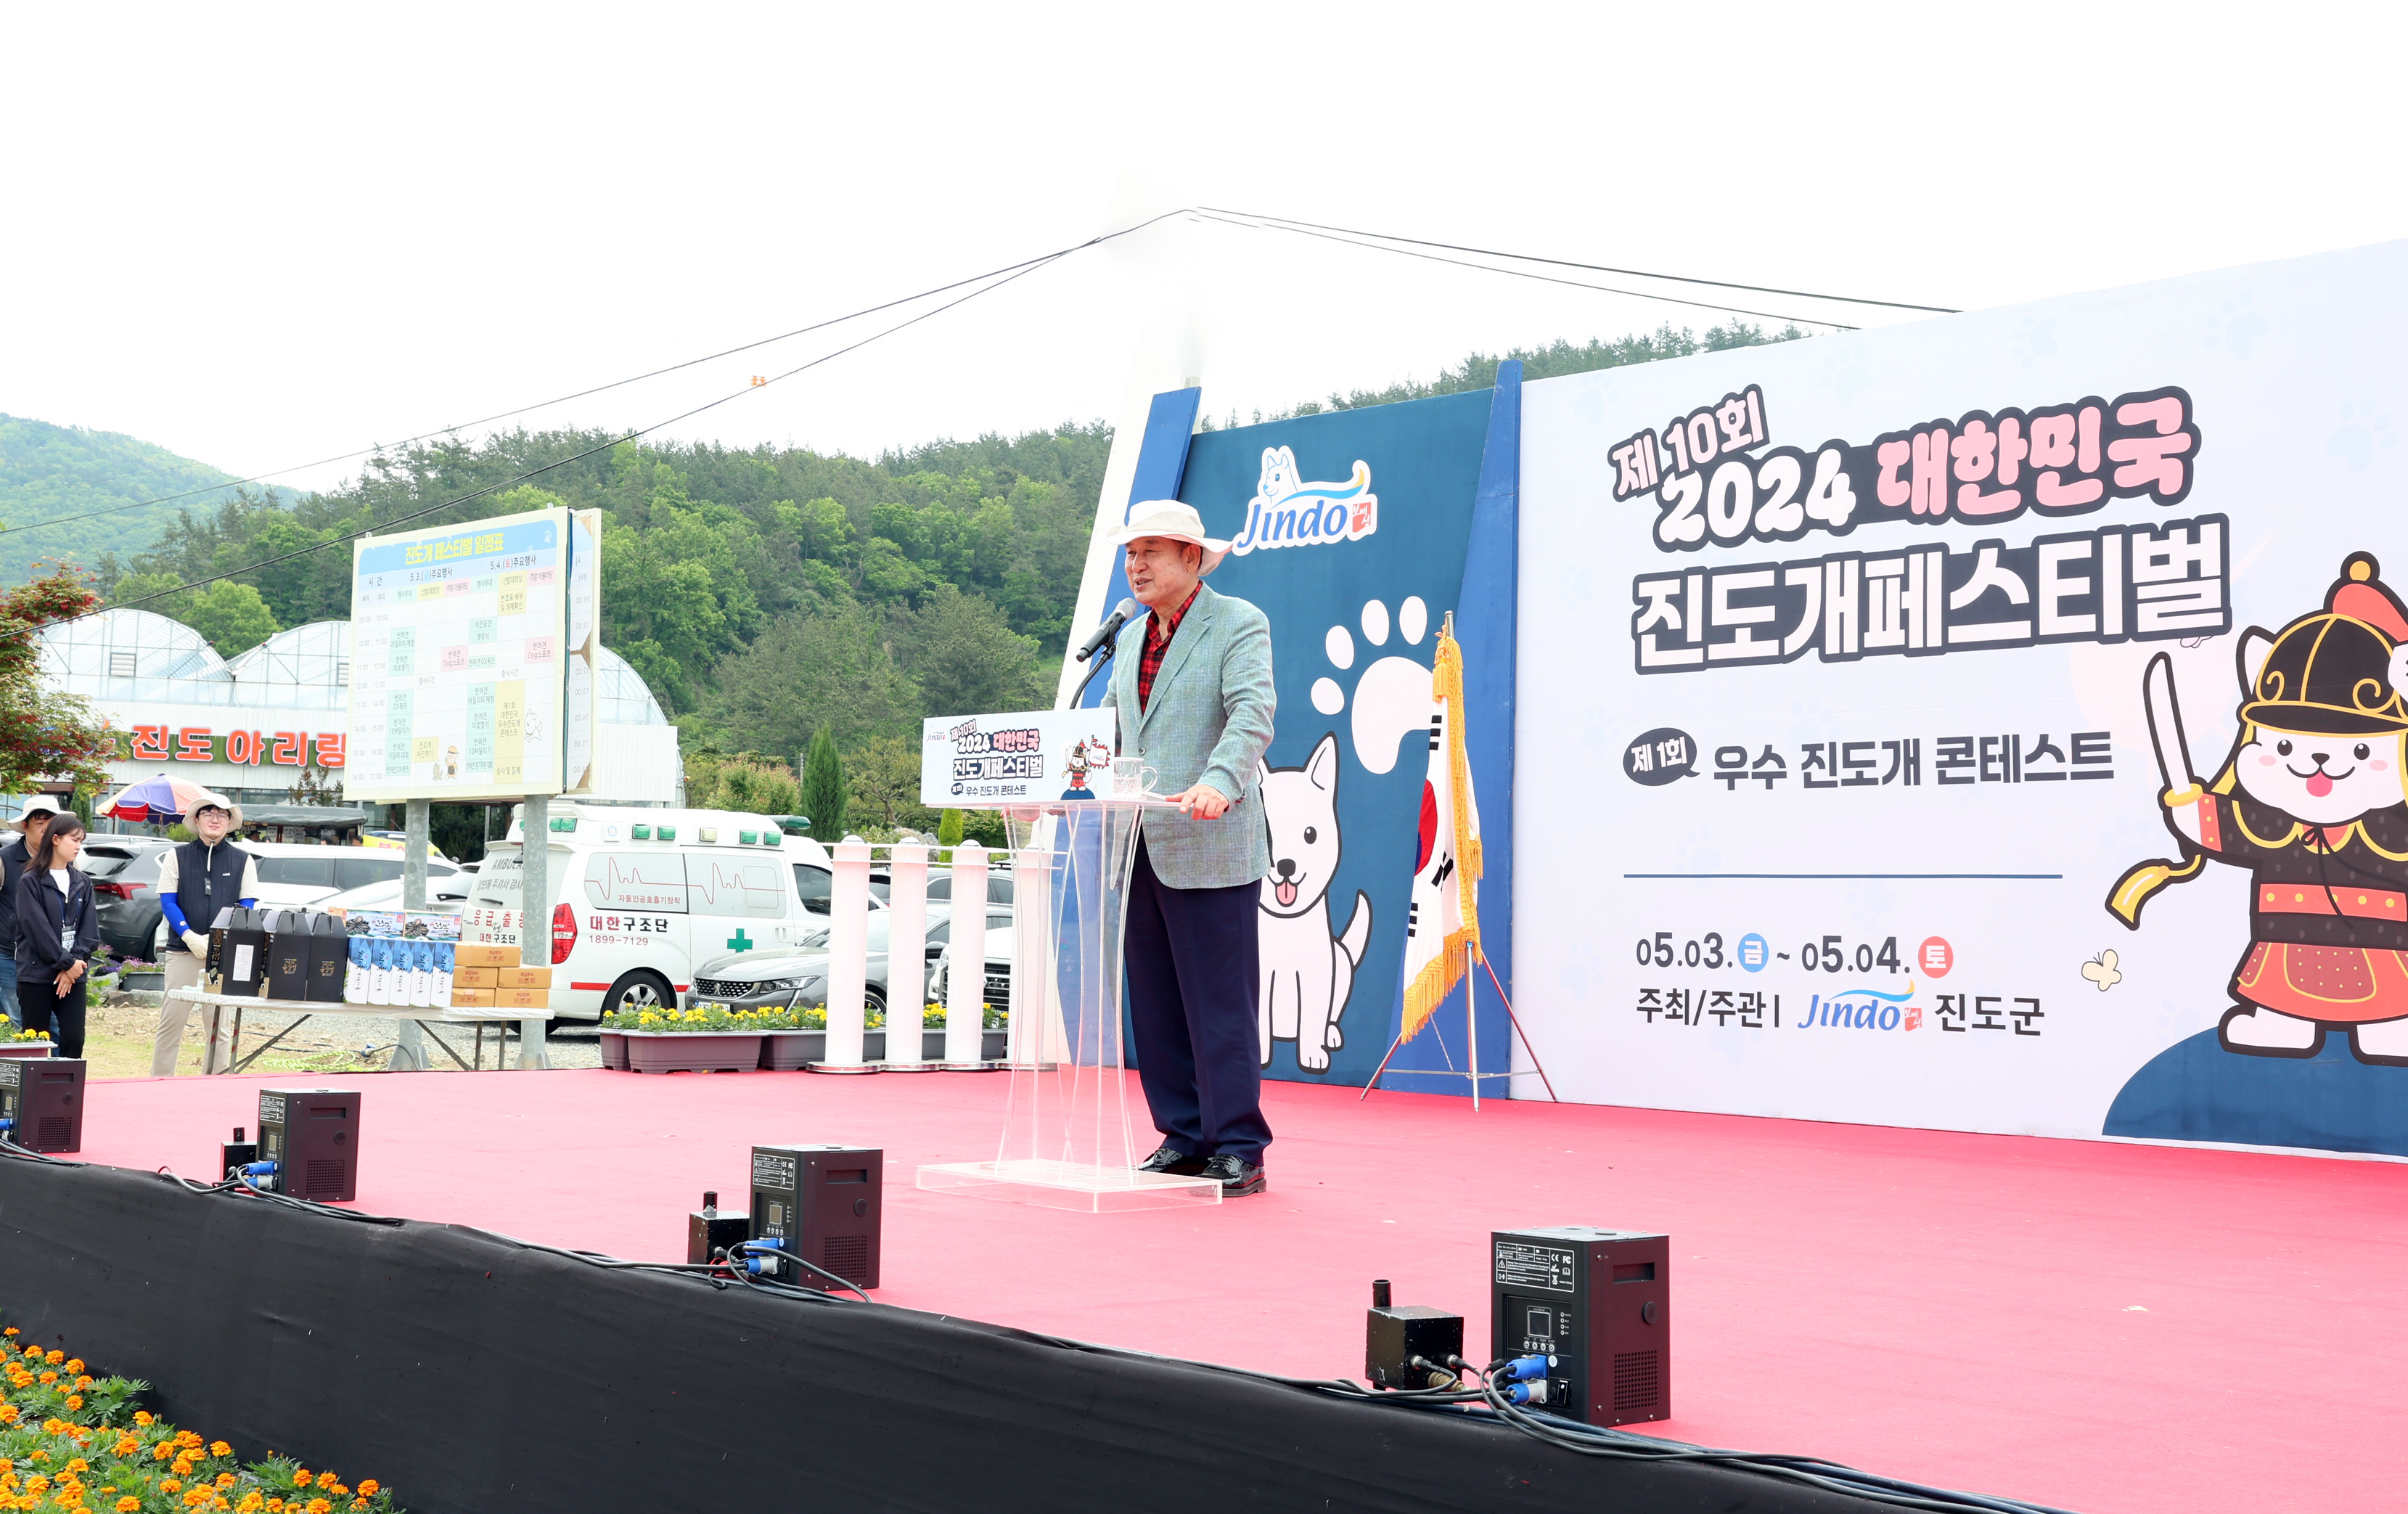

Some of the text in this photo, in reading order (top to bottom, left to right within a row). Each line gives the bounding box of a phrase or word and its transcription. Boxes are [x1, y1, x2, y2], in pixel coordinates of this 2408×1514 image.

[1658, 394, 2194, 547] 2024 대한민국
[1237, 500, 1348, 548] Jindo
[406, 533, 504, 565] 진도개 페스티벌 일정표
[501, 594, 513, 603] 번호표
[1634, 517, 2228, 671] 진도개페스티벌
[533, 642, 546, 650] 반려견
[528, 651, 551, 660] Dog스포츠
[443, 658, 464, 667] Dog스포츠
[469, 658, 480, 667] 반려견
[132, 724, 214, 762] 진도
[419, 741, 431, 750] 진도개
[958, 729, 1039, 754] 2024 대한민국
[1713, 744, 1787, 791] 우수
[1801, 738, 1921, 790] 진도개
[1935, 731, 2115, 785] 콘테스트
[953, 755, 1043, 780] 진도개페스티벌
[966, 787, 978, 796] 우수
[980, 786, 999, 796] 진도개
[1001, 785, 1026, 795] 콘테스트
[492, 859, 523, 869] AMBULA
[492, 879, 510, 890] 주셔서
[510, 879, 523, 890] 감사
[618, 895, 680, 904] 자동인공호흡기장착
[589, 935, 648, 946] 1899-7129
[1798, 994, 1901, 1031] Jindo
[1935, 994, 2046, 1036] 진도군
